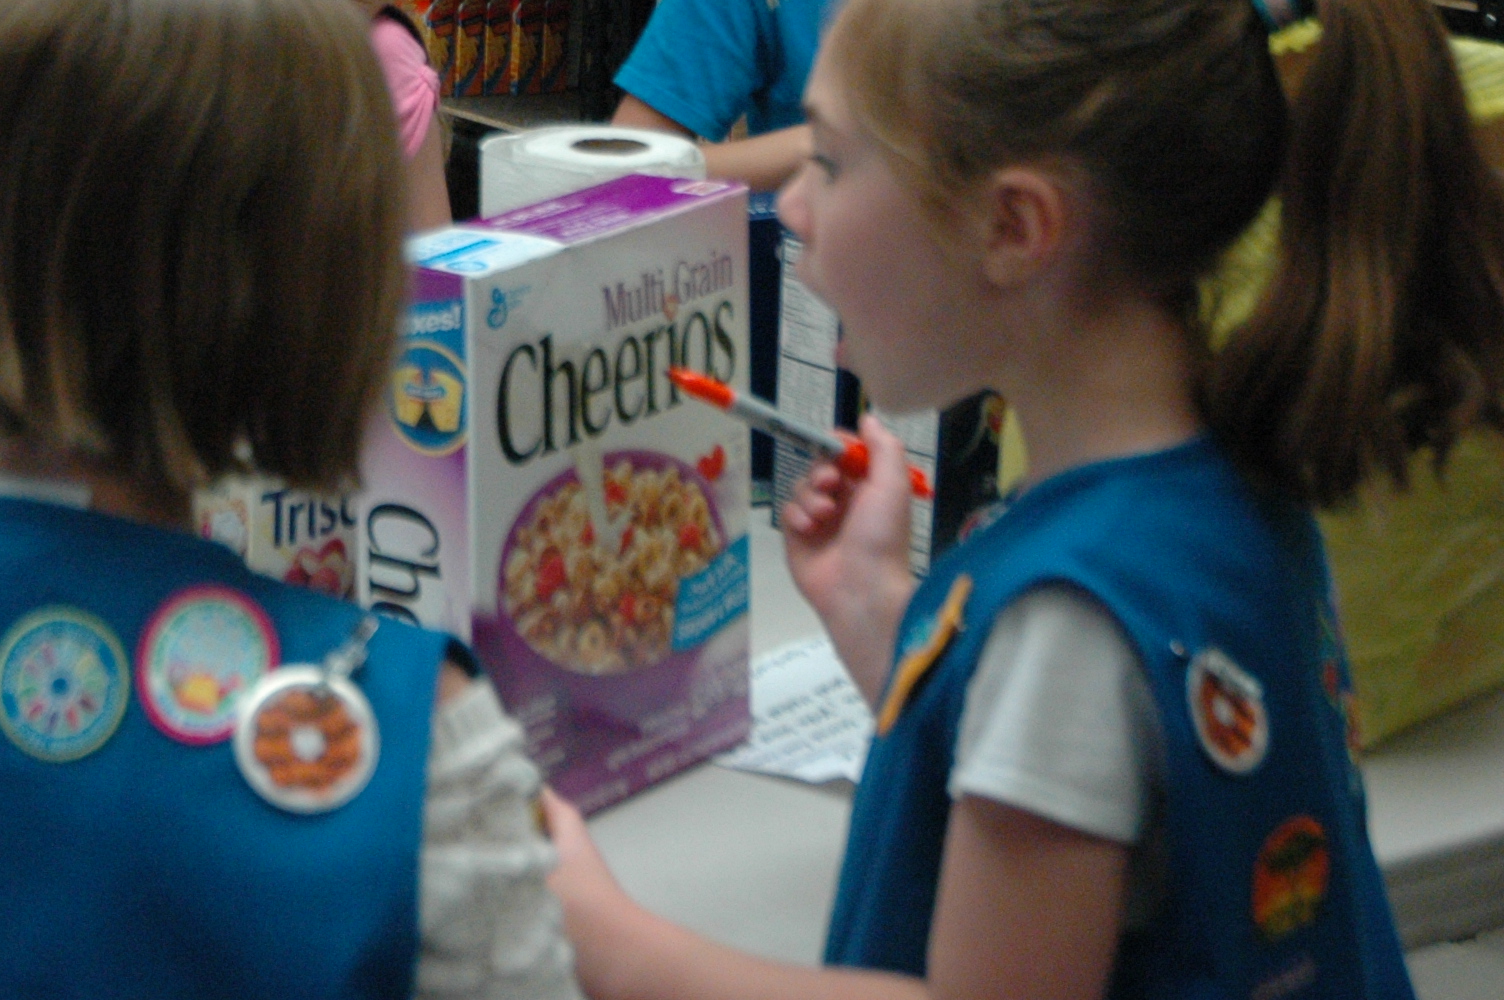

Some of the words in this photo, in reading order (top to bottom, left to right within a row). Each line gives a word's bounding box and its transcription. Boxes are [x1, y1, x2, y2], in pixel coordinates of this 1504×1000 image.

[602, 268, 666, 332] Multi
[673, 251, 734, 303] Grain
[496, 301, 737, 466] Cheerios
